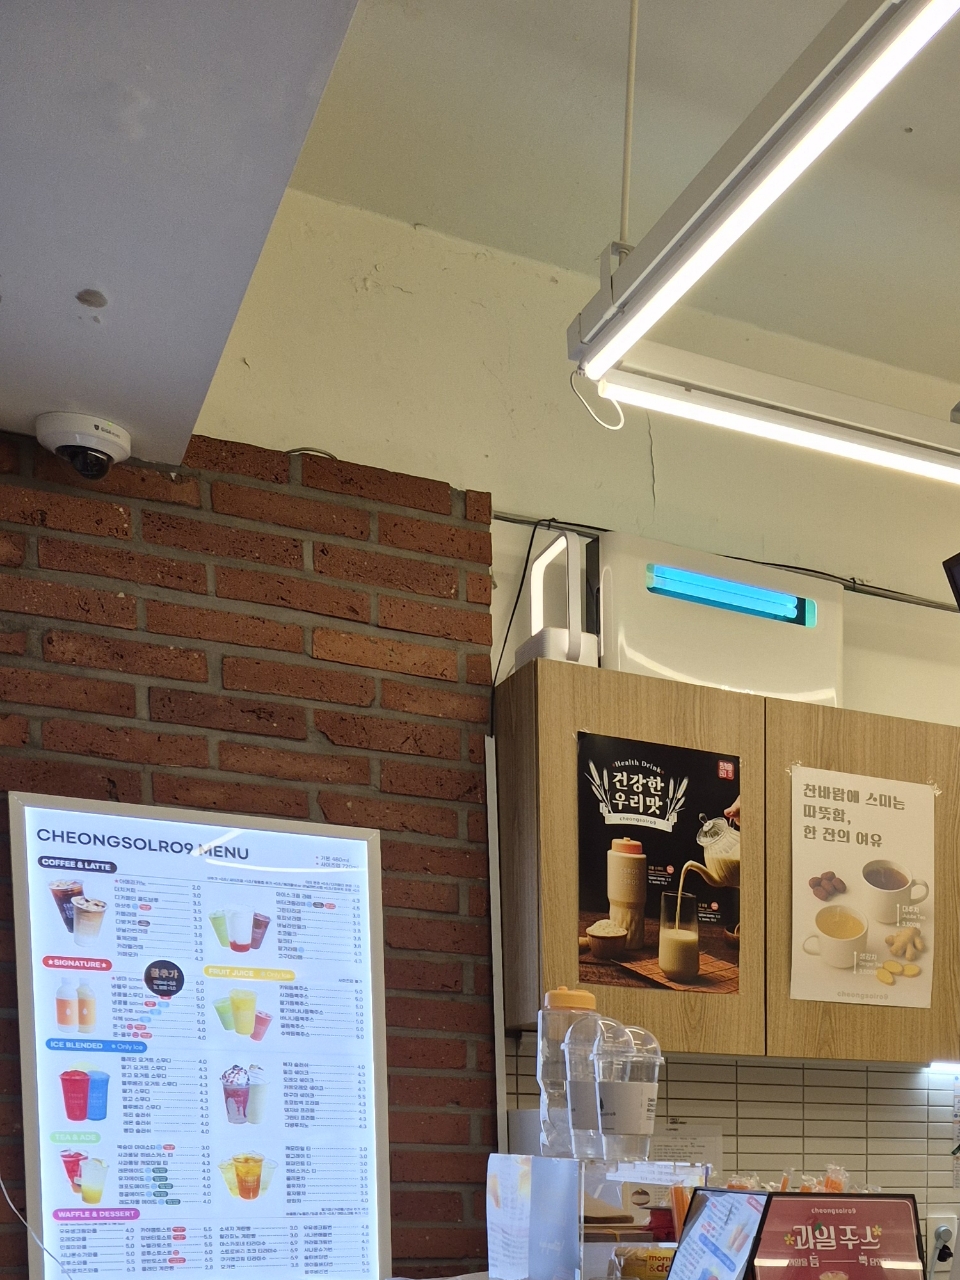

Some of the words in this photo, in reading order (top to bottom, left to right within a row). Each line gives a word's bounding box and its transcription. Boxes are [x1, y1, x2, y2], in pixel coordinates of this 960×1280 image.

[615, 759, 639, 768] Health
[641, 761, 661, 775] Drink
[612, 771, 665, 795] 건강한
[612, 791, 663, 815] 우리맛
[803, 783, 860, 805] 찬바람에
[865, 792, 906, 811] 스미는
[803, 804, 852, 826] 따뜻함,
[37, 828, 193, 855] CHEONGSOLRO9
[198, 843, 249, 860] MENU
[803, 825, 817, 840] 한
[822, 827, 851, 844] 잔의
[856, 832, 883, 848] 여유
[42, 858, 76, 868] COFFEE
[77, 861, 83, 869] &
[84, 862, 111, 871] LATTE
[54, 959, 101, 968] SIGNATURE
[209, 968, 230, 976] FRUIT
[66, 1041, 103, 1049] BLENDED
[117, 1043, 132, 1051] Only
[99, 1210, 136, 1218] DESSERT
[793, 1225, 837, 1250] 과일
[839, 1225, 881, 1250] 주스
